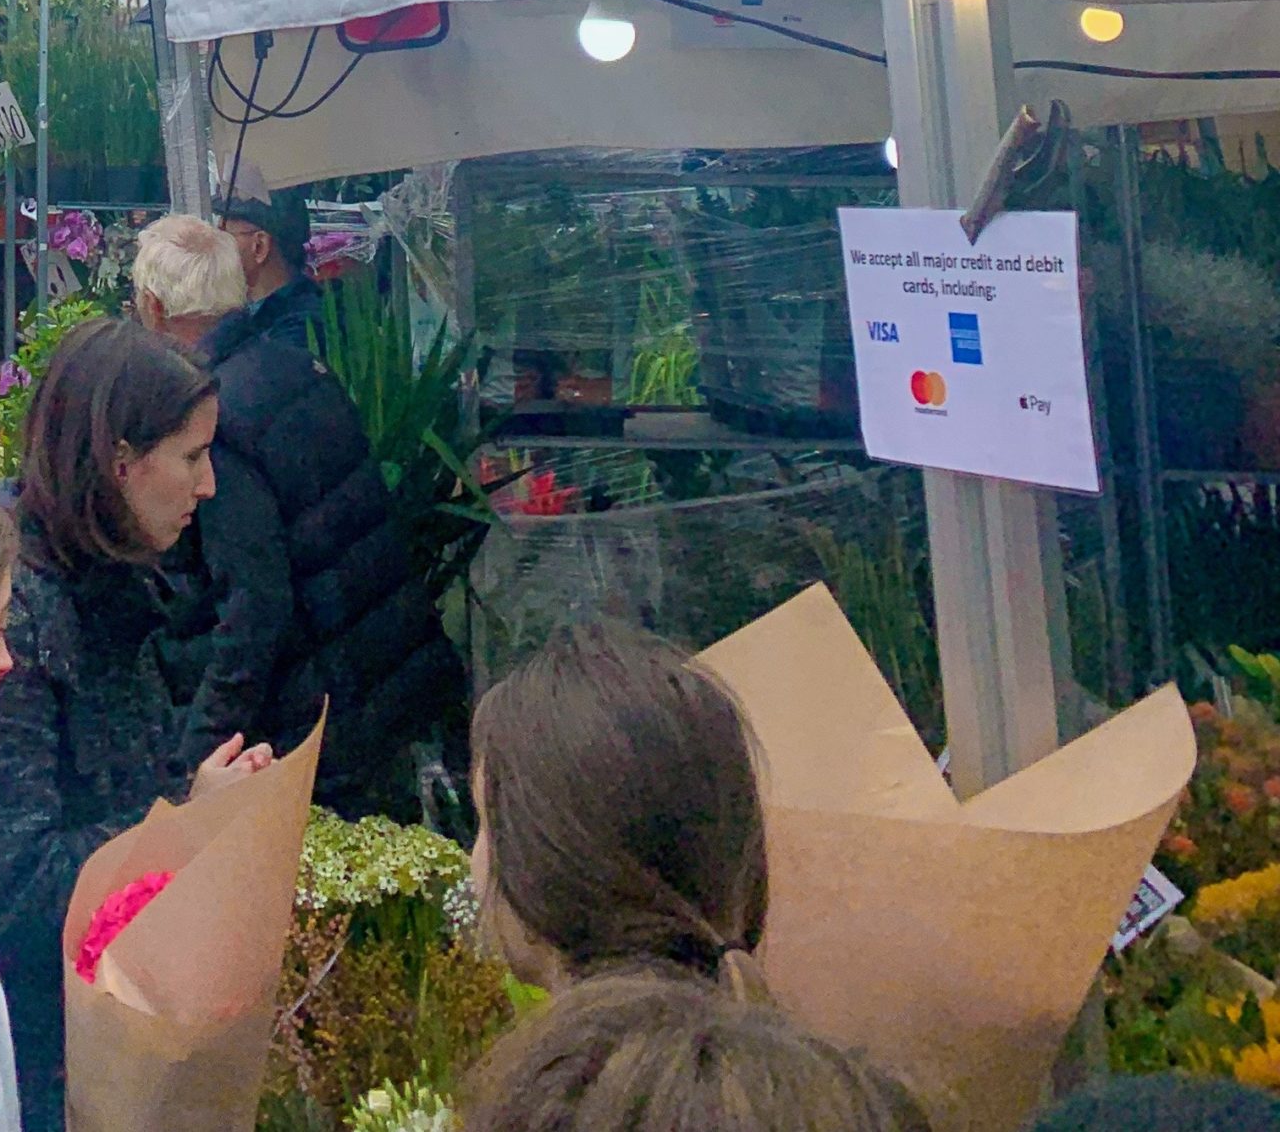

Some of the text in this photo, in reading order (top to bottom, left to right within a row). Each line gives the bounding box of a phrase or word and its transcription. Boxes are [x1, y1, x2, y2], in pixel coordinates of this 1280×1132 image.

[850, 250, 1065, 274] We accept all major credit and debit
[903, 277, 997, 302] cards, including:
[866, 320, 900, 343] VISA
[1030, 394, 1051, 417] Pay
